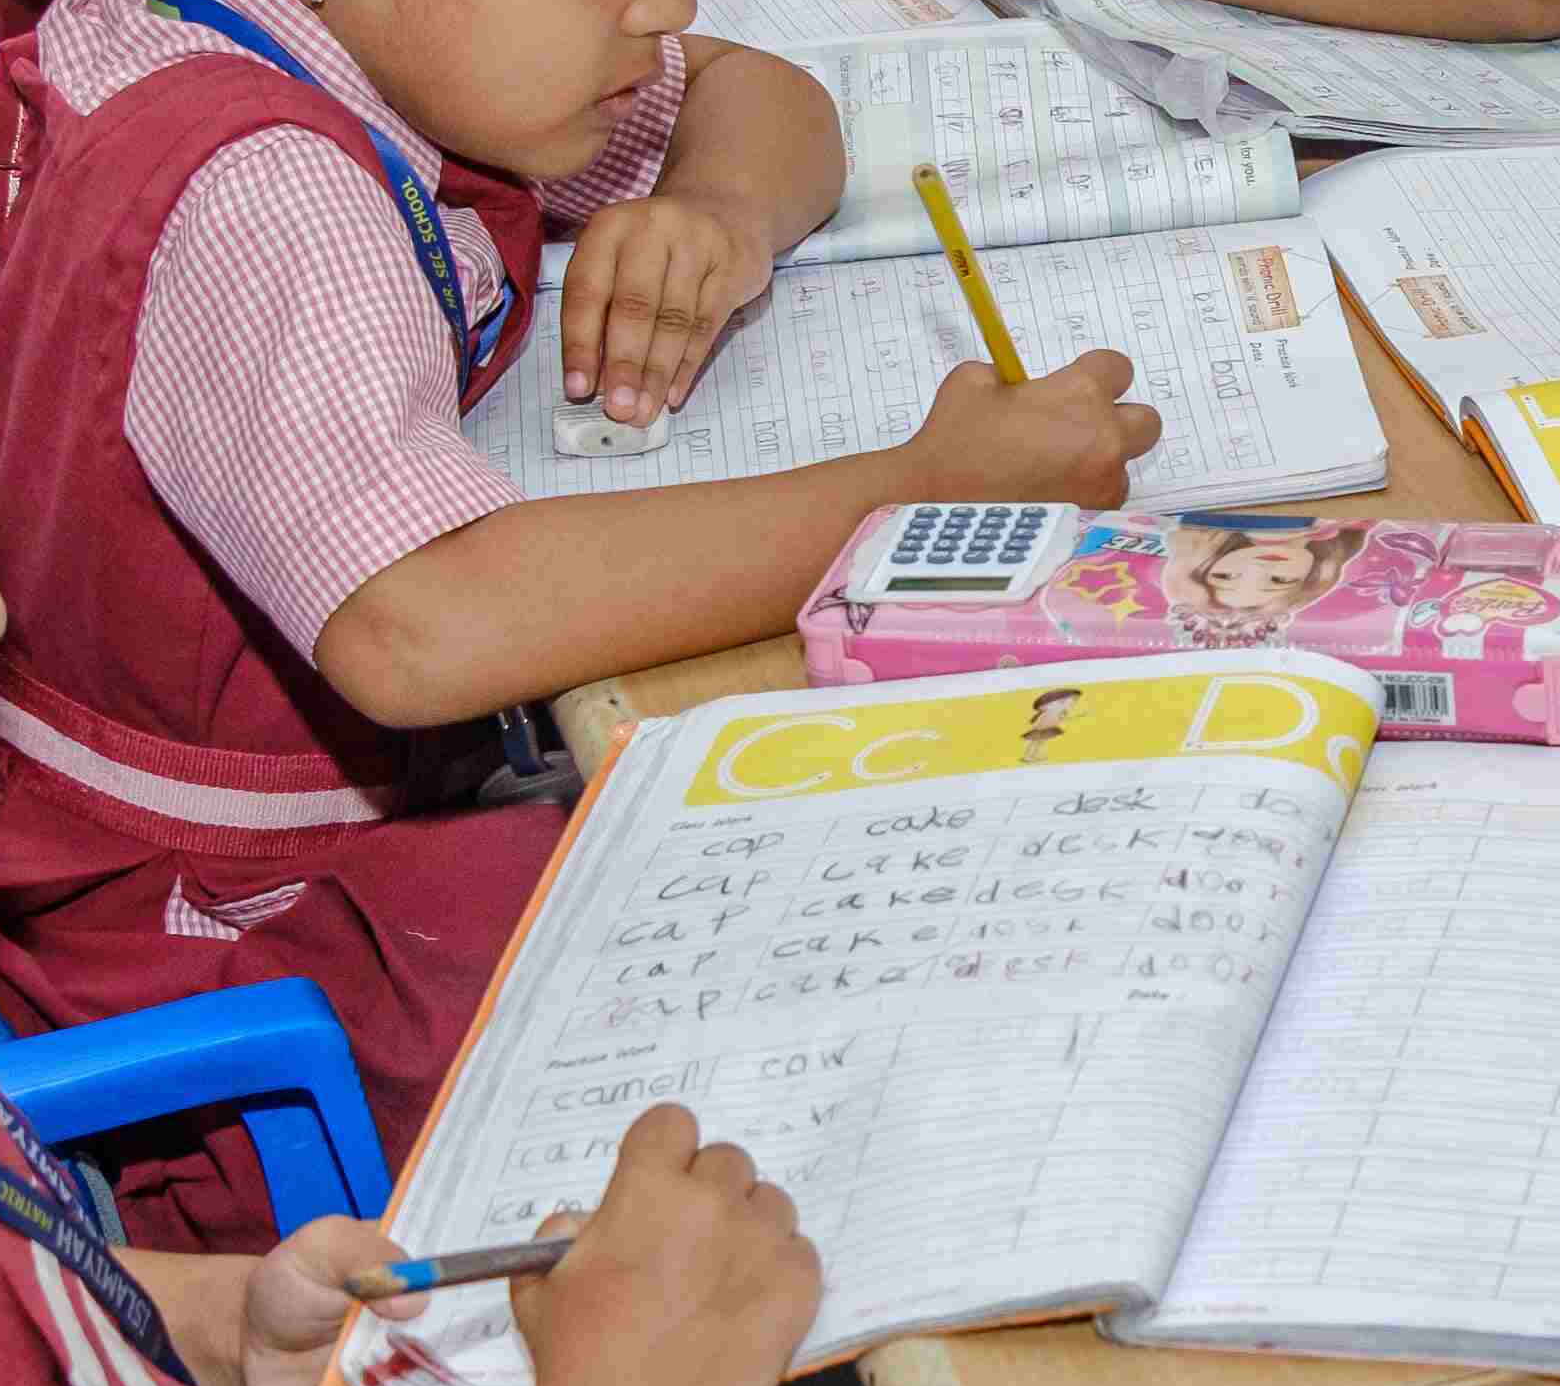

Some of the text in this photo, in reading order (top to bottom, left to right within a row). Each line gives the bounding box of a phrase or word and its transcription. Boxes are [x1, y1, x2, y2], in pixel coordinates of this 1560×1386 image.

[401, 175, 438, 244] SCHOOL
[1264, 292, 1290, 317] Drill
[865, 806, 976, 837] cake
[1052, 787, 1159, 815] desk
[658, 868, 771, 900] cap
[821, 846, 971, 882] cake
[801, 886, 958, 917] cake
[772, 924, 938, 958] cake
[760, 1035, 857, 1080] cow
[53, 1217, 153, 1340] ISLAMIYAH
